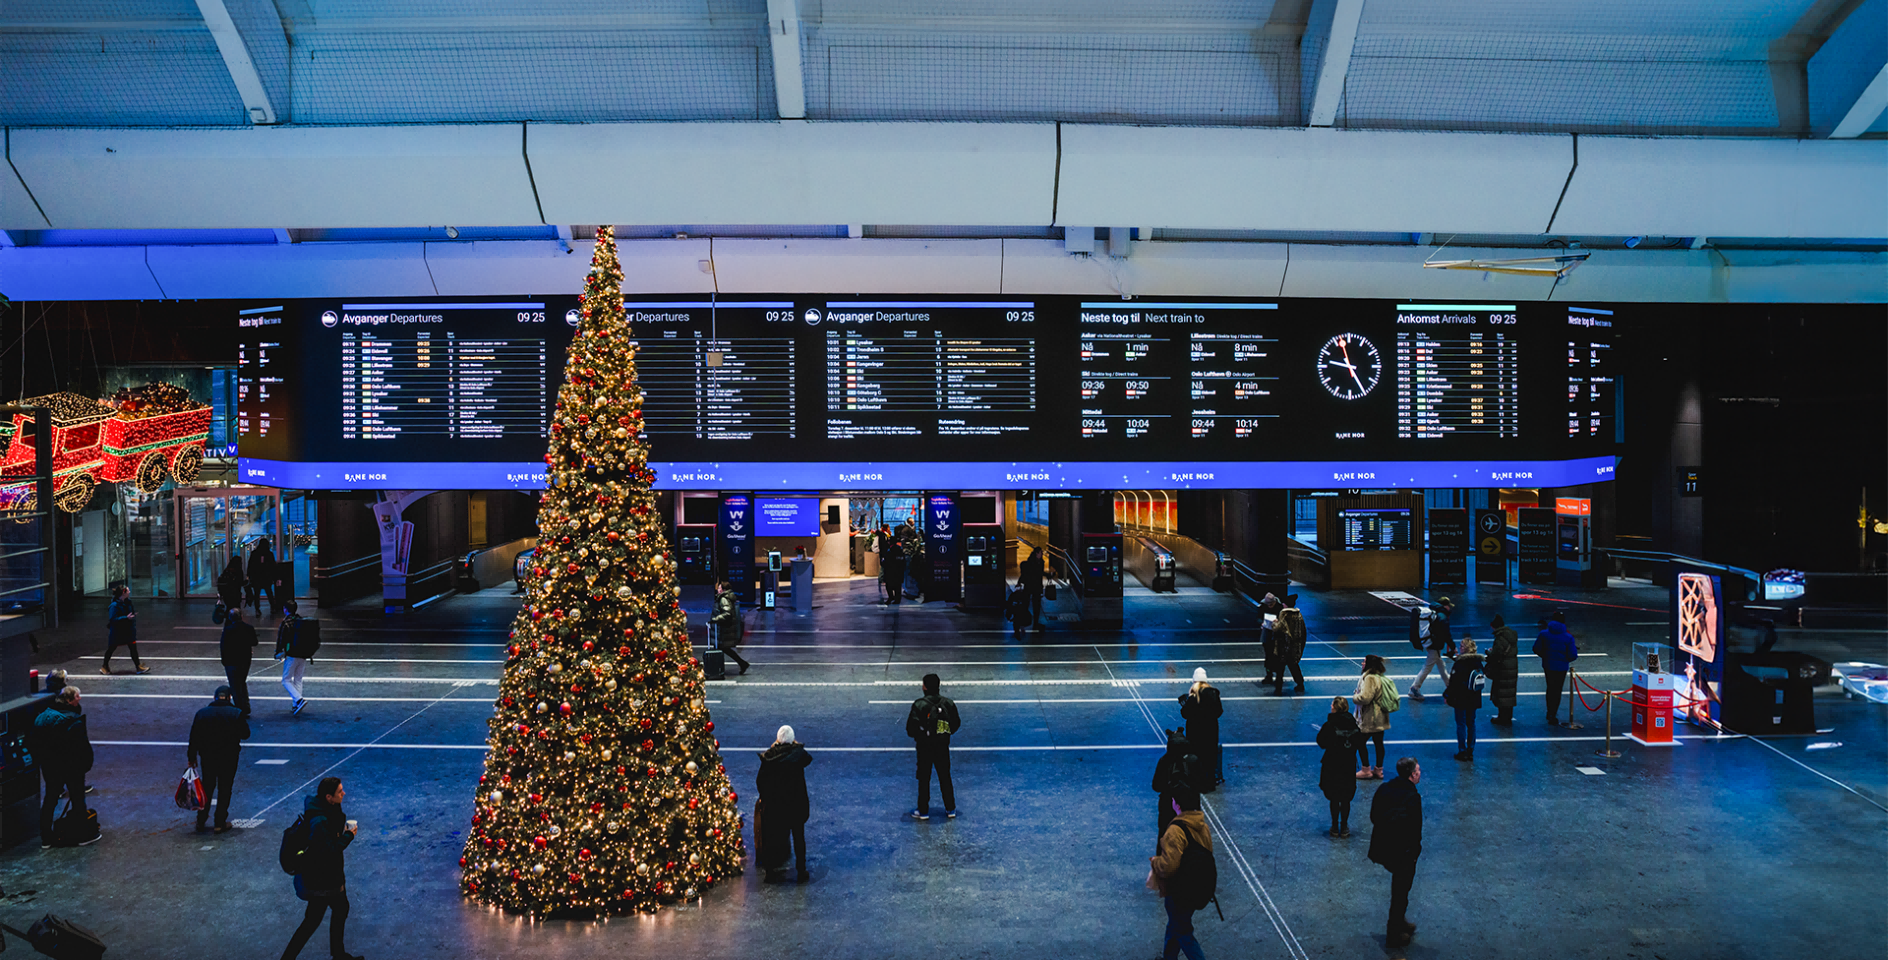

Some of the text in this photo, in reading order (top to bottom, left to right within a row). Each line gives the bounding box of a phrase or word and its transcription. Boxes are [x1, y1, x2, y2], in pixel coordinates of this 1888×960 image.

[342, 312, 546, 326] Avganger Departures 09 25
[636, 312, 690, 324] Departures
[766, 312, 780, 322] 09
[782, 312, 794, 322] 25
[826, 312, 1034, 324] Avganger Departures 09 25
[1082, 312, 1204, 324] Neste tog til Next train to
[1396, 314, 1516, 324] Ankomst Arrivals 09 25
[1082, 342, 1094, 352] Nå
[1126, 342, 1148, 352] 1 min
[1192, 342, 1204, 352] Nå
[1234, 342, 1258, 352] 8 min
[1082, 380, 1104, 390] 09:36
[1126, 380, 1150, 390] 09:50
[1192, 380, 1204, 390] Nå
[1234, 382, 1258, 390] 4 min
[1082, 420, 1106, 428] 09:44
[1126, 420, 1150, 428] 10:04
[1192, 420, 1214, 428] 09:44
[1236, 420, 1258, 428] 10:14
[344, 474, 366, 482] BANE
[508, 474, 528, 482] BANE
[672, 474, 694, 482] BANE
[840, 474, 862, 482] BANE
[1006, 474, 1028, 482] BANE
[1172, 474, 1194, 482] BANE
[1334, 472, 1354, 482] BANE
[1492, 472, 1512, 480] BANE
[1686, 482, 1696, 492] 11
[729, 511, 744, 519] VY
[936, 510, 950, 519] VY
